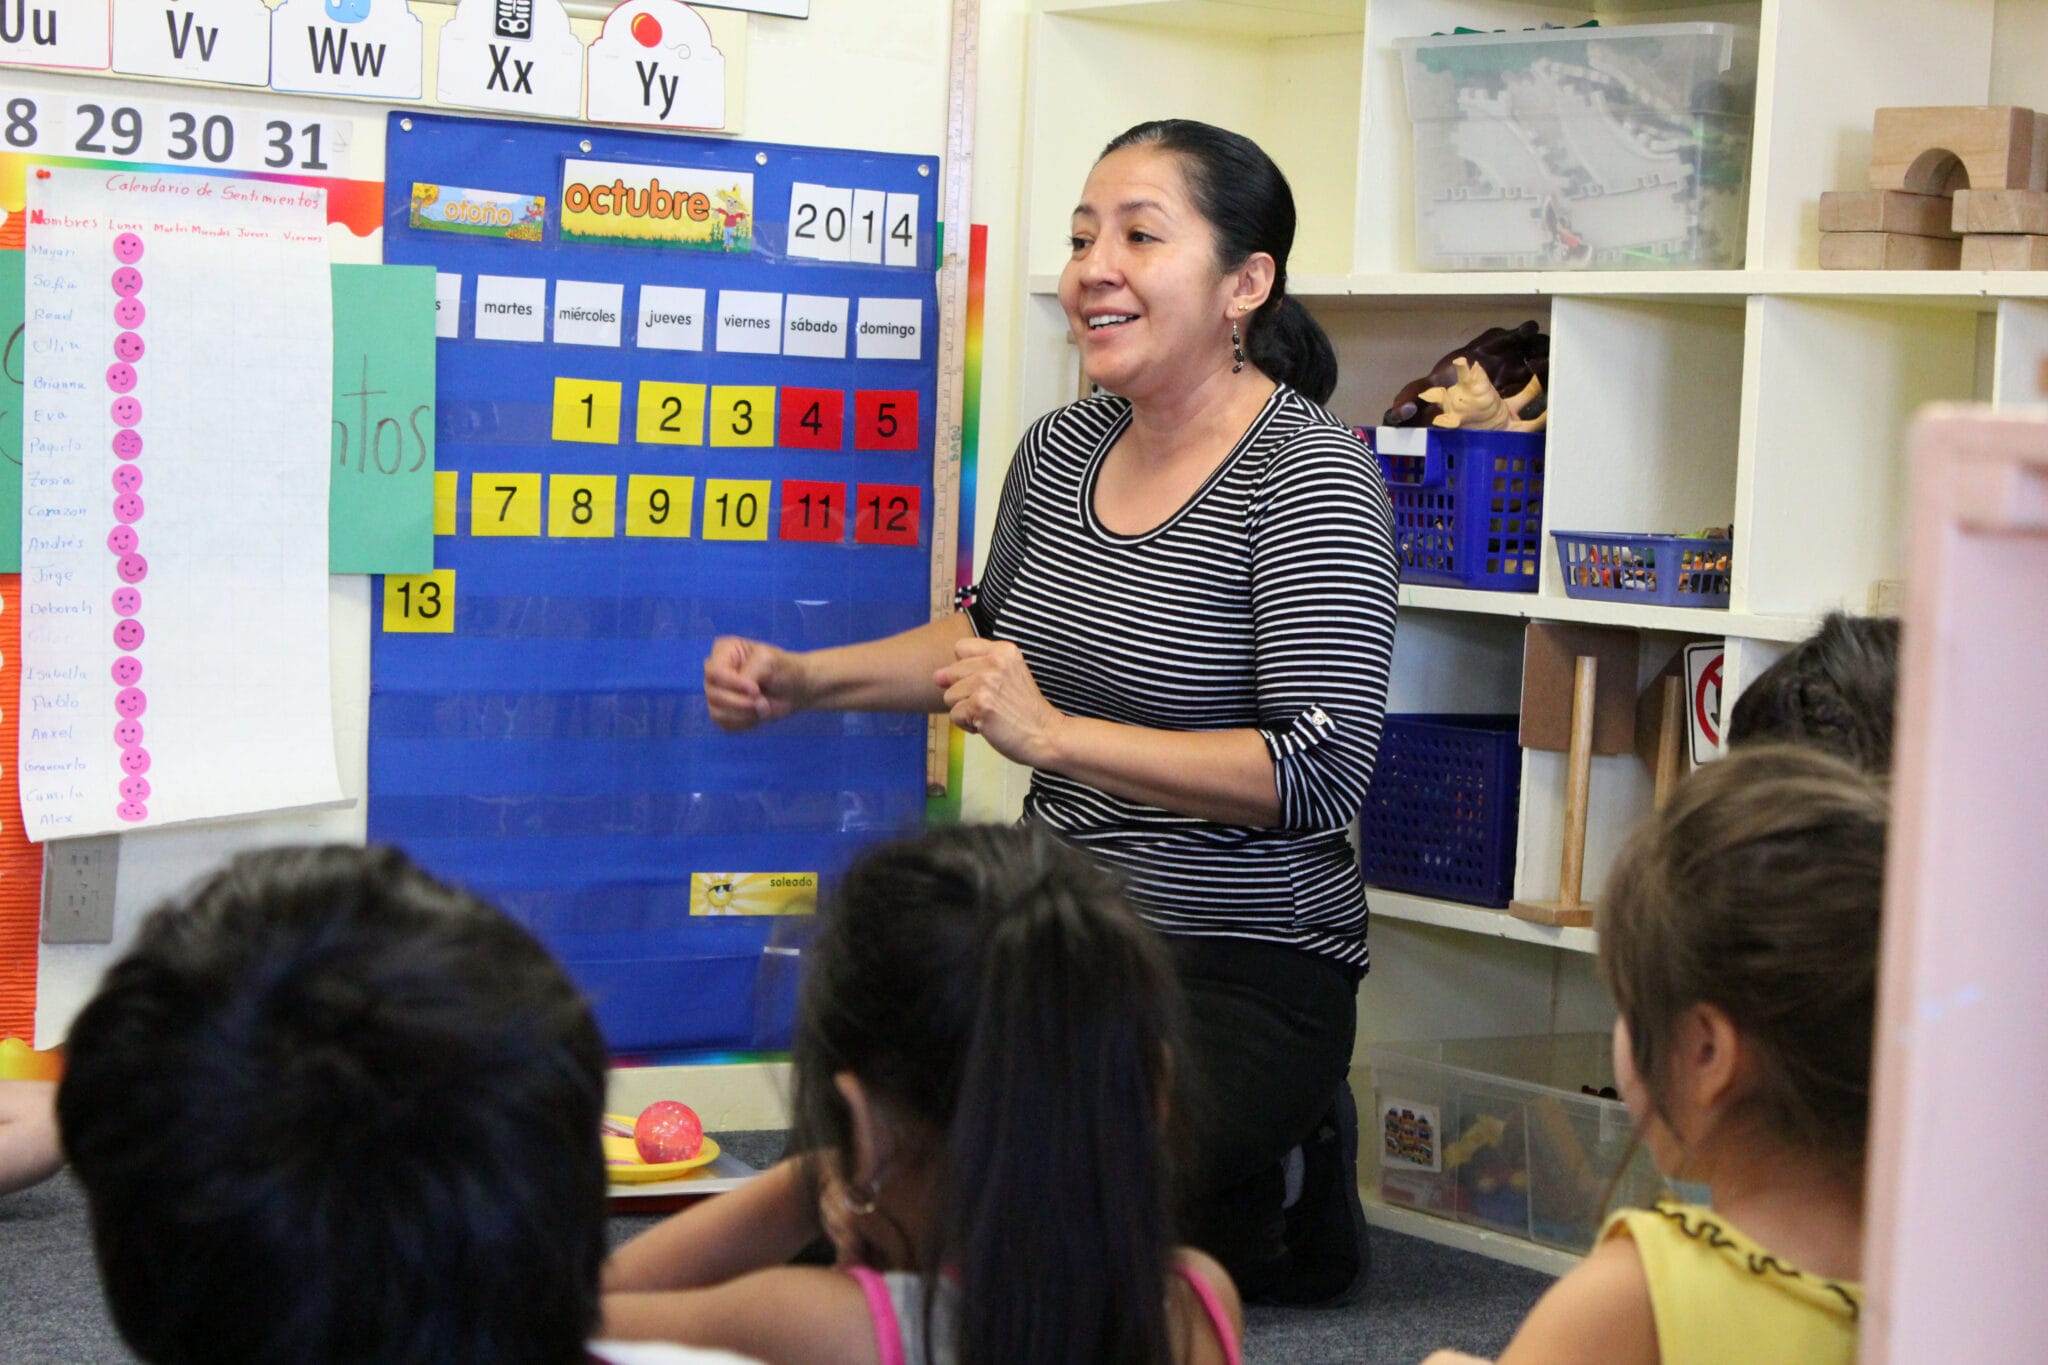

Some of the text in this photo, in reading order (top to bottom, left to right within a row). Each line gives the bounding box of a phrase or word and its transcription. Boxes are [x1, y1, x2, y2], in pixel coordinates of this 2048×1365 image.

[0, 0, 56, 46] Uu
[166, 10, 218, 62] Vv
[308, 26, 386, 77] Ww
[486, 44, 534, 94] Xx
[636, 61, 679, 120] Yy
[75, 103, 143, 155] 29
[167, 112, 234, 163] 30
[264, 120, 328, 170] 31
[105, 174, 319, 210] Calendario de Sentimientos
[444, 198, 513, 227] otoño
[565, 178, 711, 222] octubre
[30, 209, 98, 228] Nombres
[108, 219, 143, 231] Lunes
[795, 203, 912, 248] 2014
[484, 301, 533, 316] martes
[559, 306, 616, 323] miércoles
[645, 310, 692, 328] jueves
[724, 314, 771, 329] viernes
[790, 317, 838, 334] sábado
[859, 321, 916, 339] domingo
[34, 409, 68, 422] Eva
[581, 393, 898, 438] 1 2 3 4 5
[495, 486, 909, 531] 7 8 9 10 11 12
[30, 600, 92, 615] Deborah
[397, 581, 441, 619] 13
[32, 693, 79, 712] Pablo
[40, 813, 73, 826] Alex
[770, 876, 813, 888] soleado
